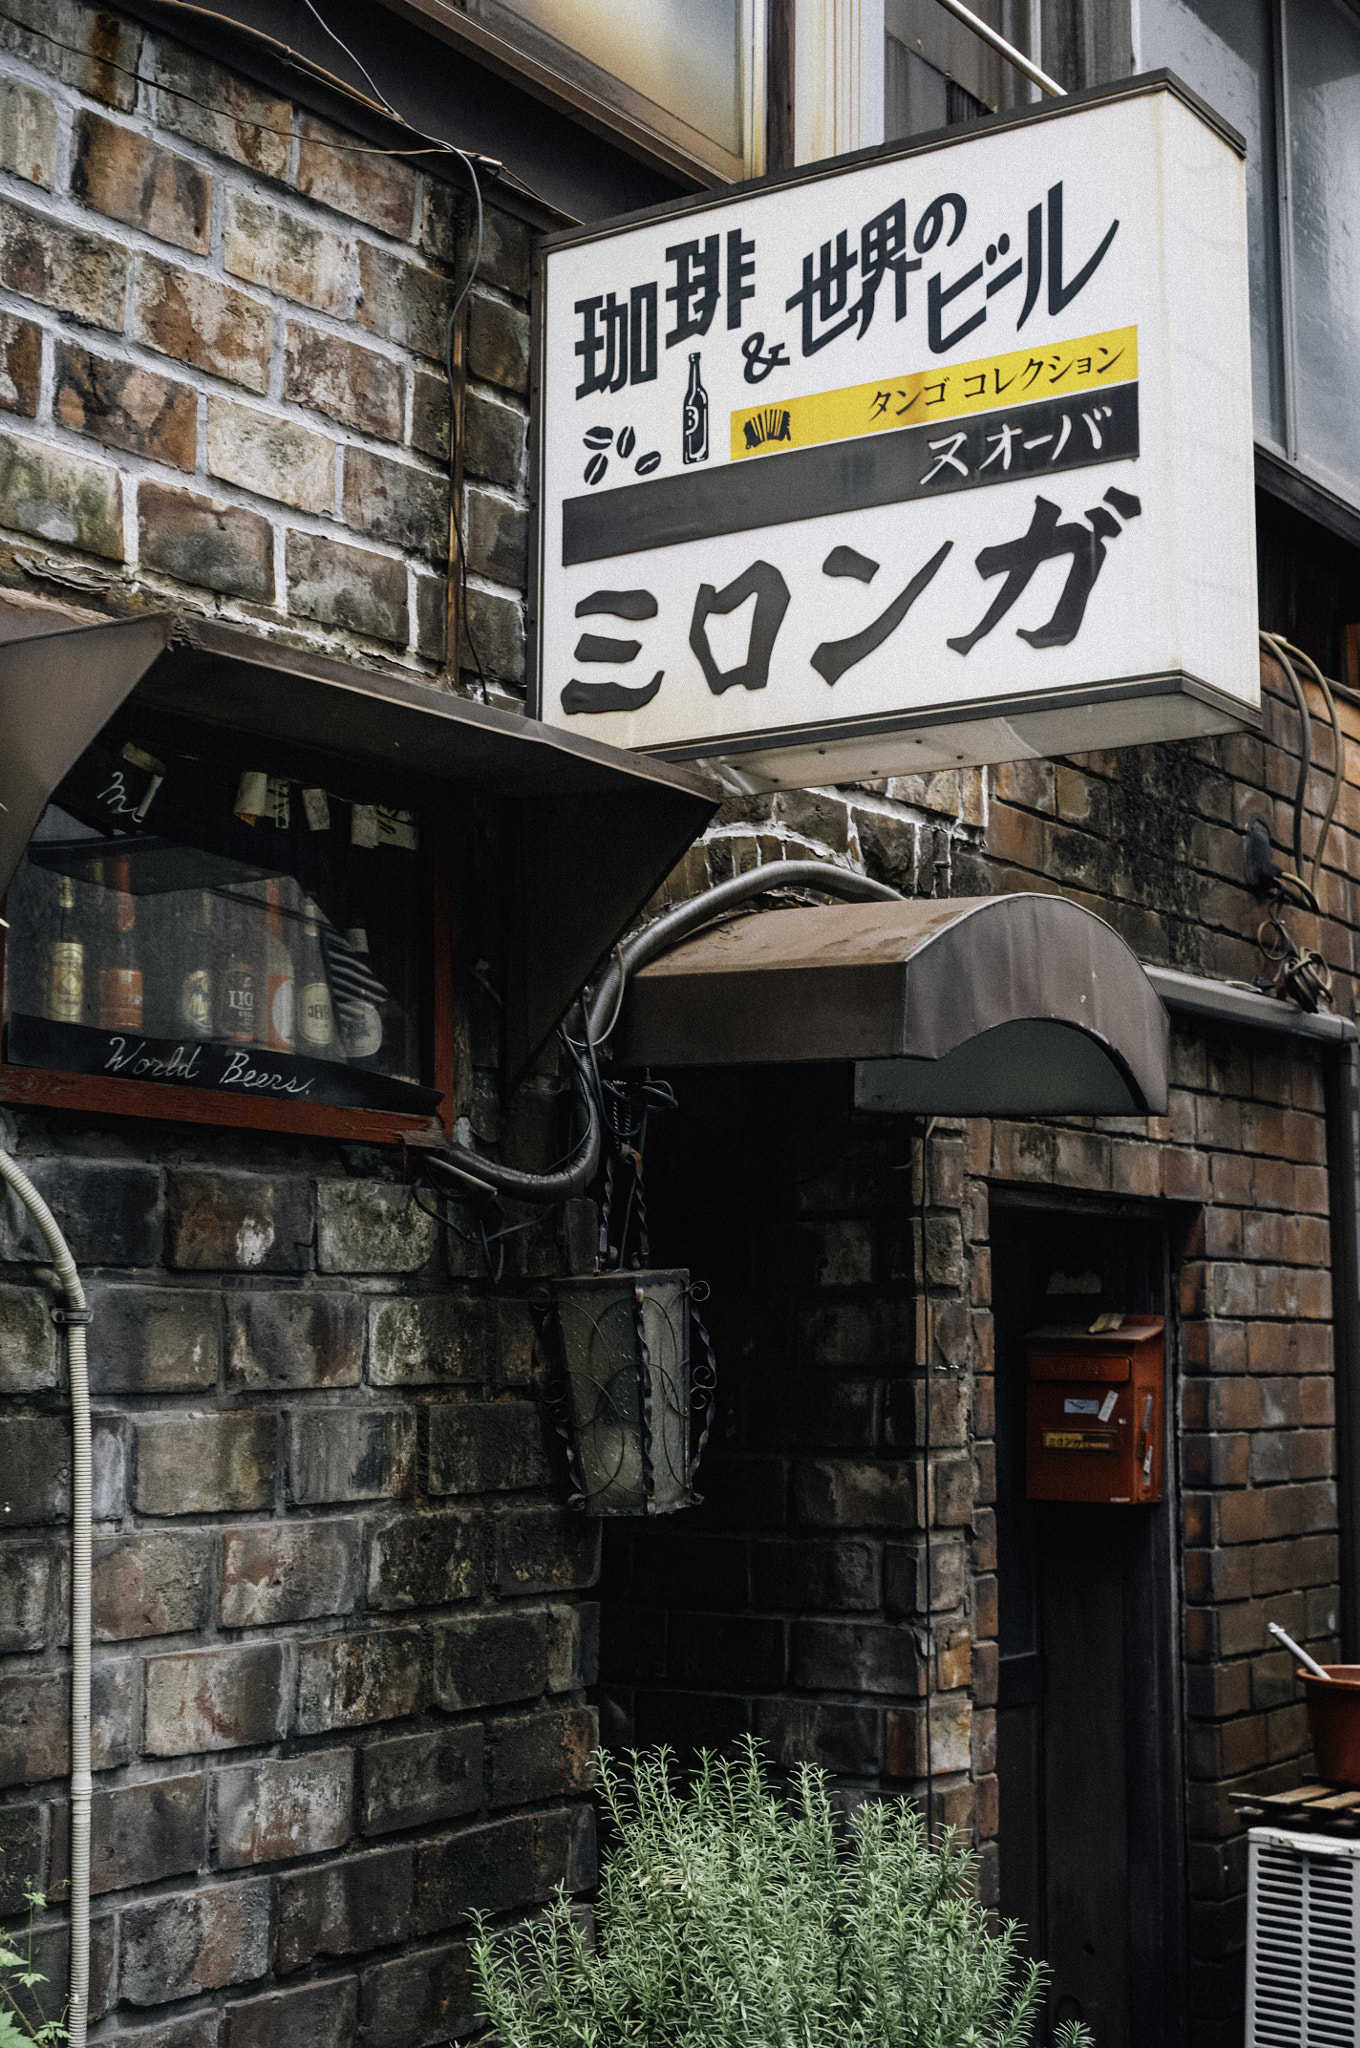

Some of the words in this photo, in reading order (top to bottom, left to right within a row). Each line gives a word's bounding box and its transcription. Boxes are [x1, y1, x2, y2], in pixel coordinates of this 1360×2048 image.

[574, 227, 756, 400] 珈琲
[868, 377, 950, 422] タンゴ
[963, 347, 1126, 398] コレクション
[919, 405, 1113, 485] ヌオーバ
[560, 486, 1142, 716] ミロンガ
[104, 1036, 202, 1079] World
[218, 1051, 315, 1095] Beers.
